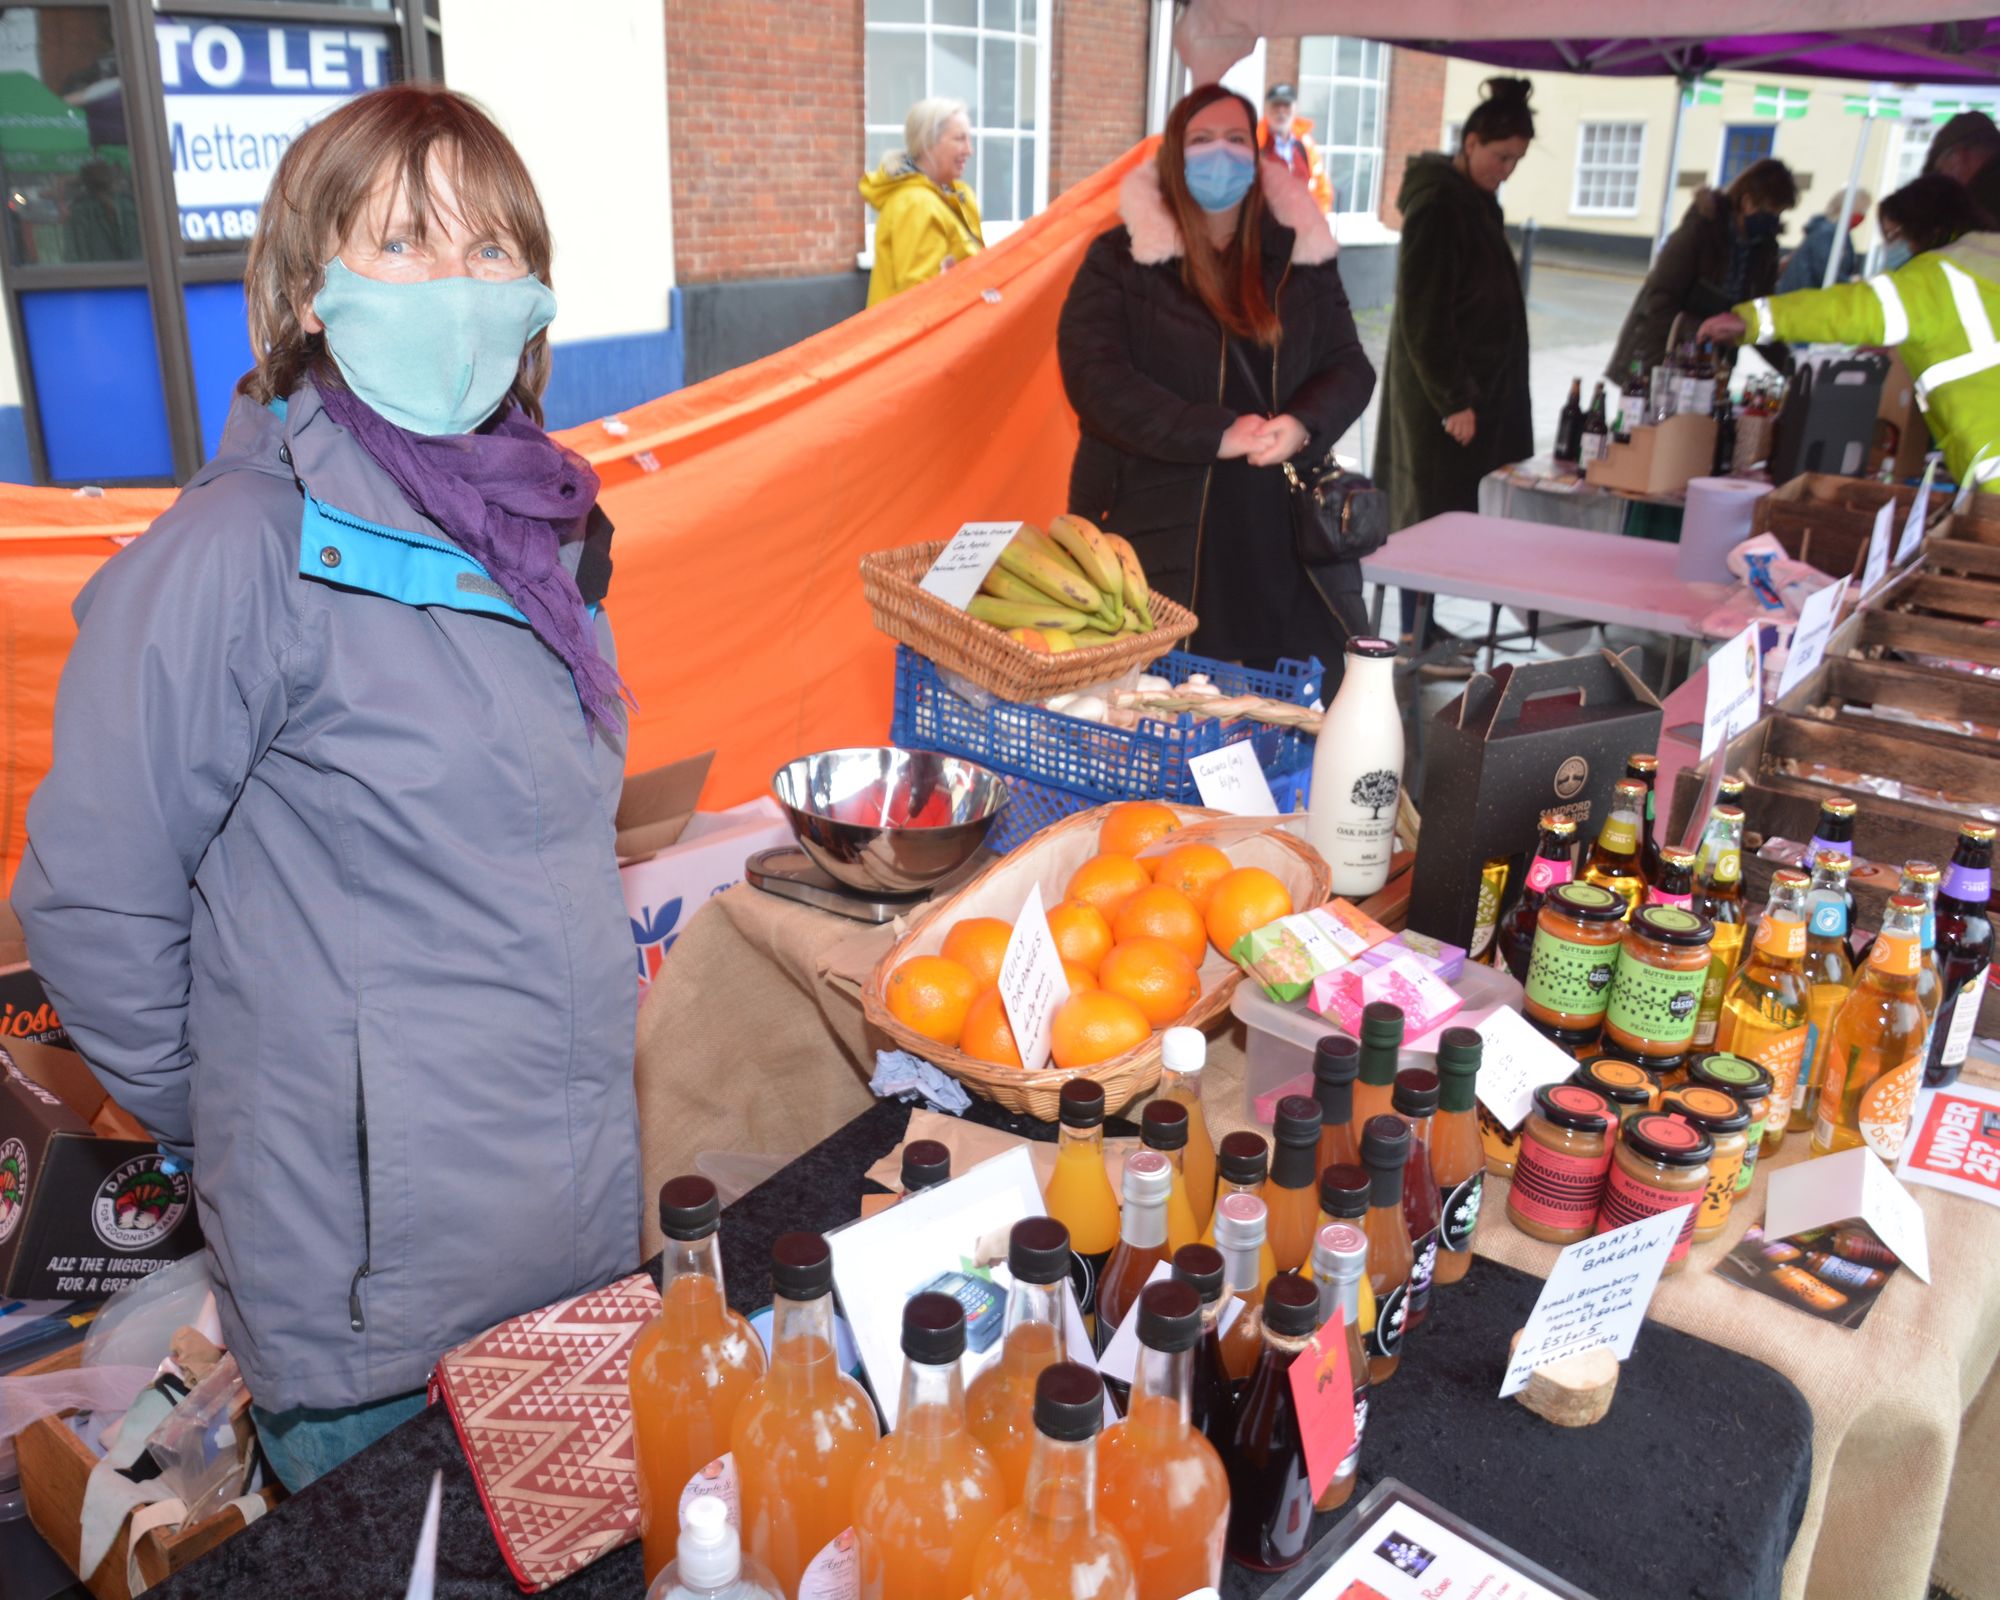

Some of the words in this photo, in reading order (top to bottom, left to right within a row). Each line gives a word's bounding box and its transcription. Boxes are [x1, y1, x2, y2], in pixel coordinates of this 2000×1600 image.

[156, 25, 244, 87] TO
[268, 29, 388, 87] LET
[1540, 800, 1591, 818] SANDFORD
[1336, 827, 1355, 836] OAK
[1642, 968, 1675, 981] BUTTER
[1925, 1101, 1981, 1170] UNDER
[105, 1159, 147, 1193] DART
[100, 1203, 110, 1223] FOR
[105, 1223, 155, 1241] GOODNESS
[46, 1257, 76, 1272] ALL
[79, 1257, 105, 1272] THE
[57, 1278, 83, 1291] FOR
[86, 1278, 97, 1291] A
